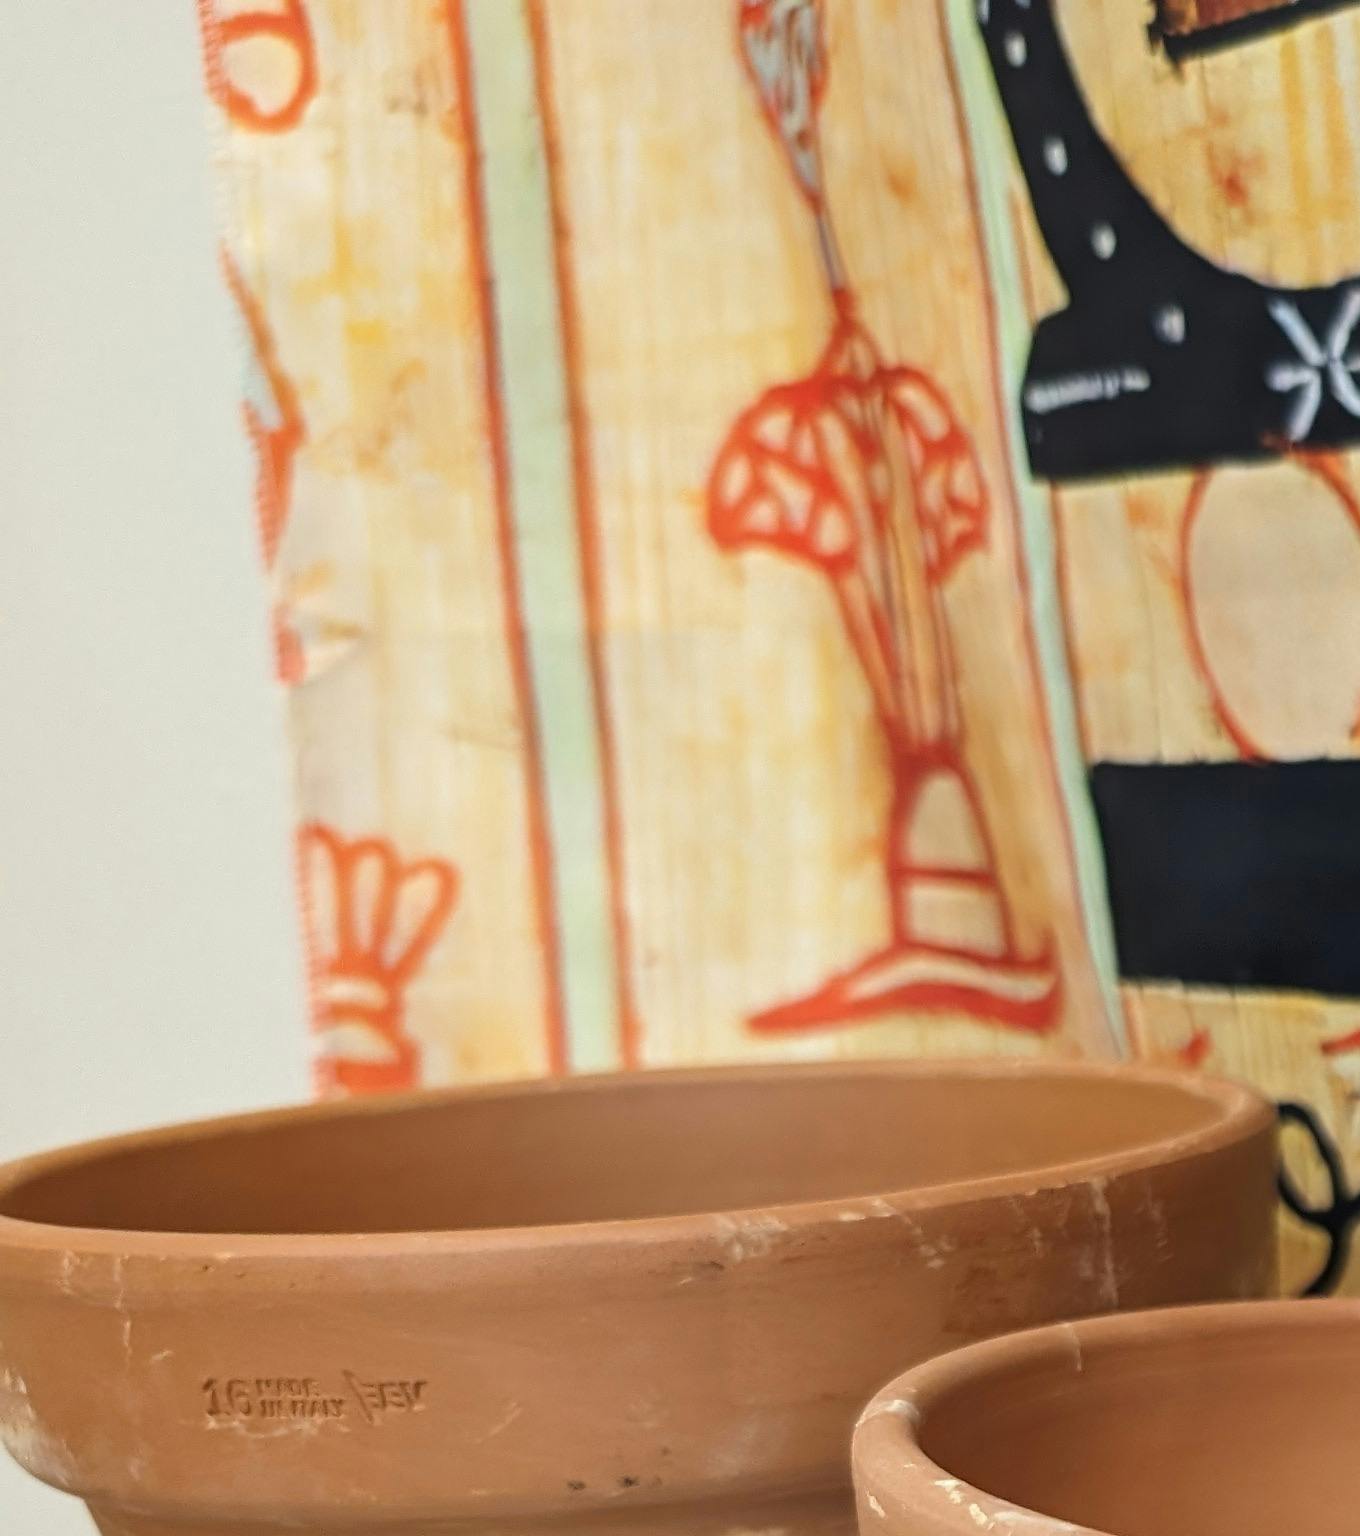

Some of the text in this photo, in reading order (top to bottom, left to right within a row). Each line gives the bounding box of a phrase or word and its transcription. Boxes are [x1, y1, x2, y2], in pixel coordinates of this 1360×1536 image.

[254, 1377, 321, 1396] MADE
[202, 1377, 251, 1417] 16
[290, 1398, 346, 1418] ITALY
